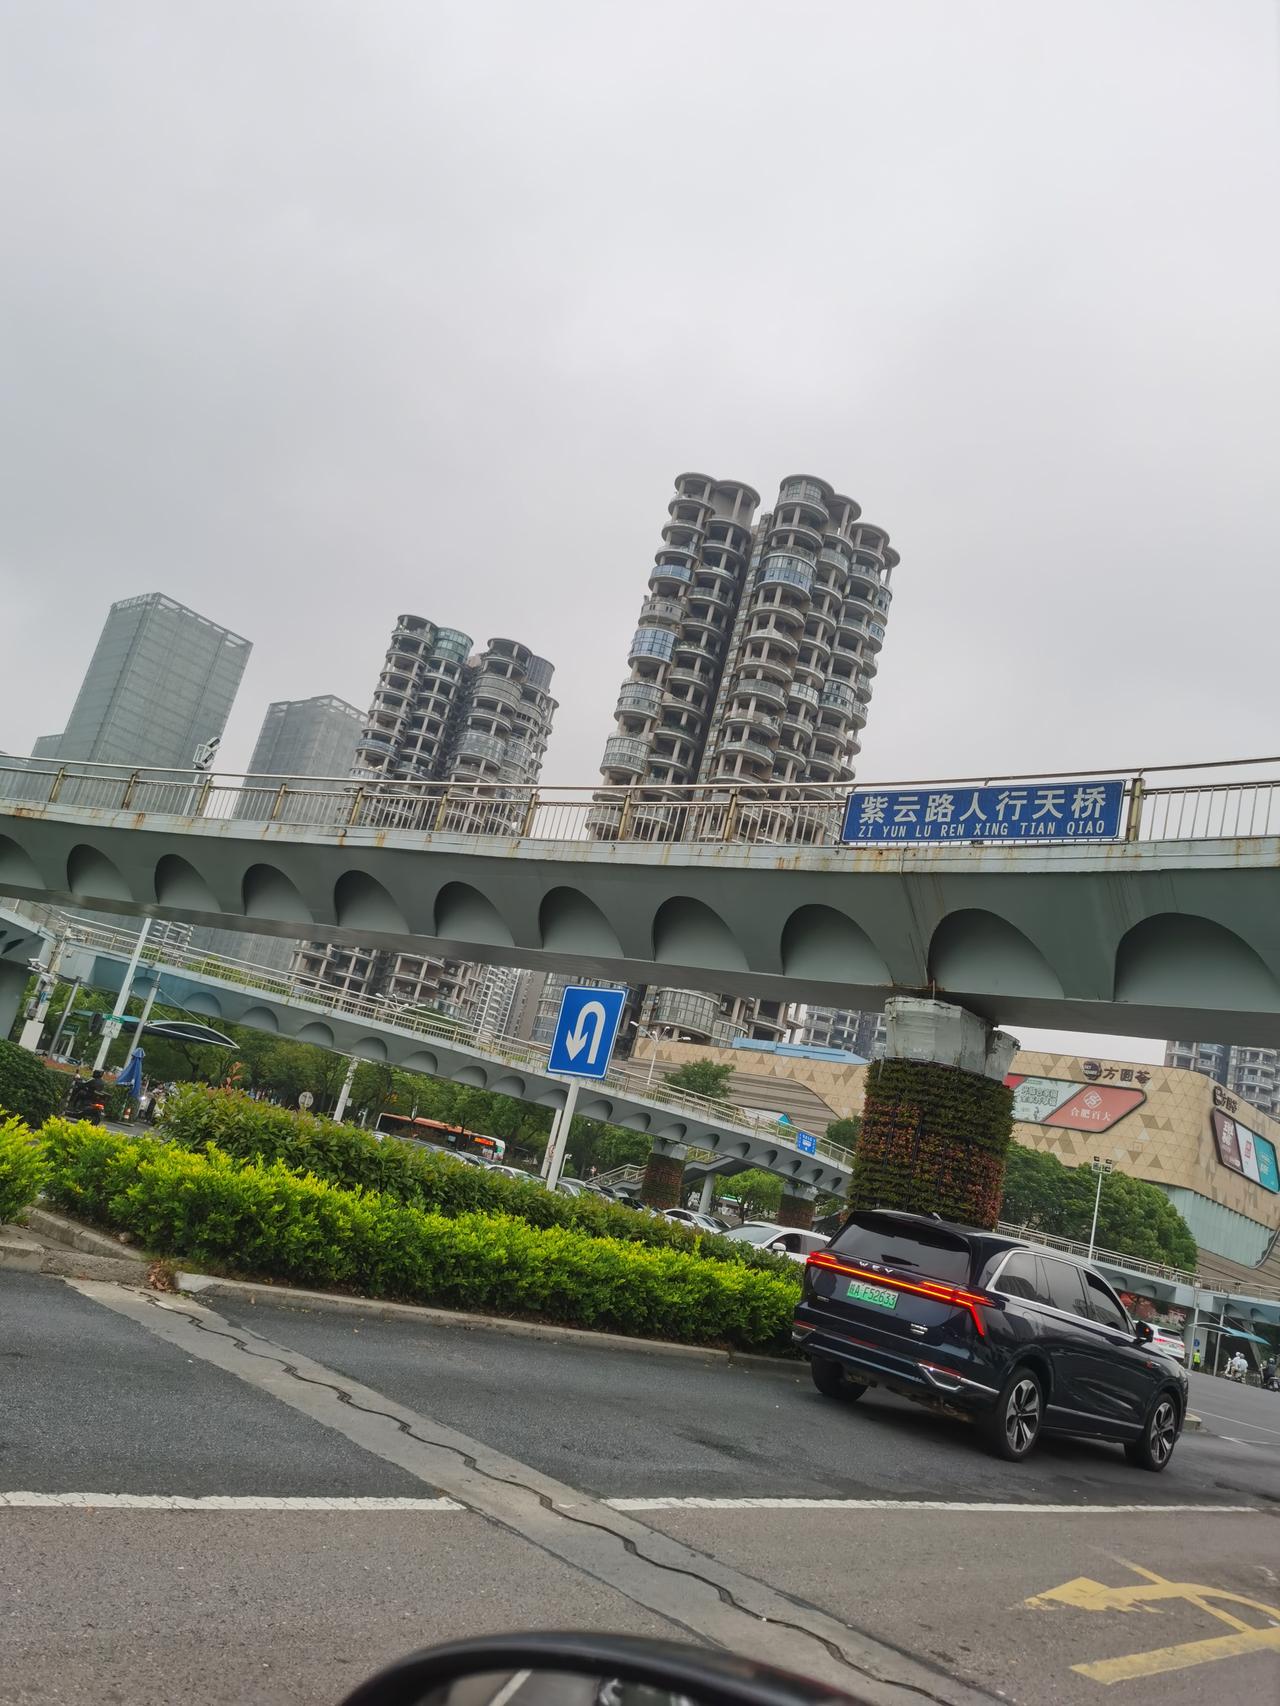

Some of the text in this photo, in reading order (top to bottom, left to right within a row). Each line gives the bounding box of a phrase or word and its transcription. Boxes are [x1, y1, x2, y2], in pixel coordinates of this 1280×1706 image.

[859, 786, 1106, 824] 紫云路人行天桥
[858, 820, 1105, 838] ZI YUN LU REN XING TIAN QIAO
